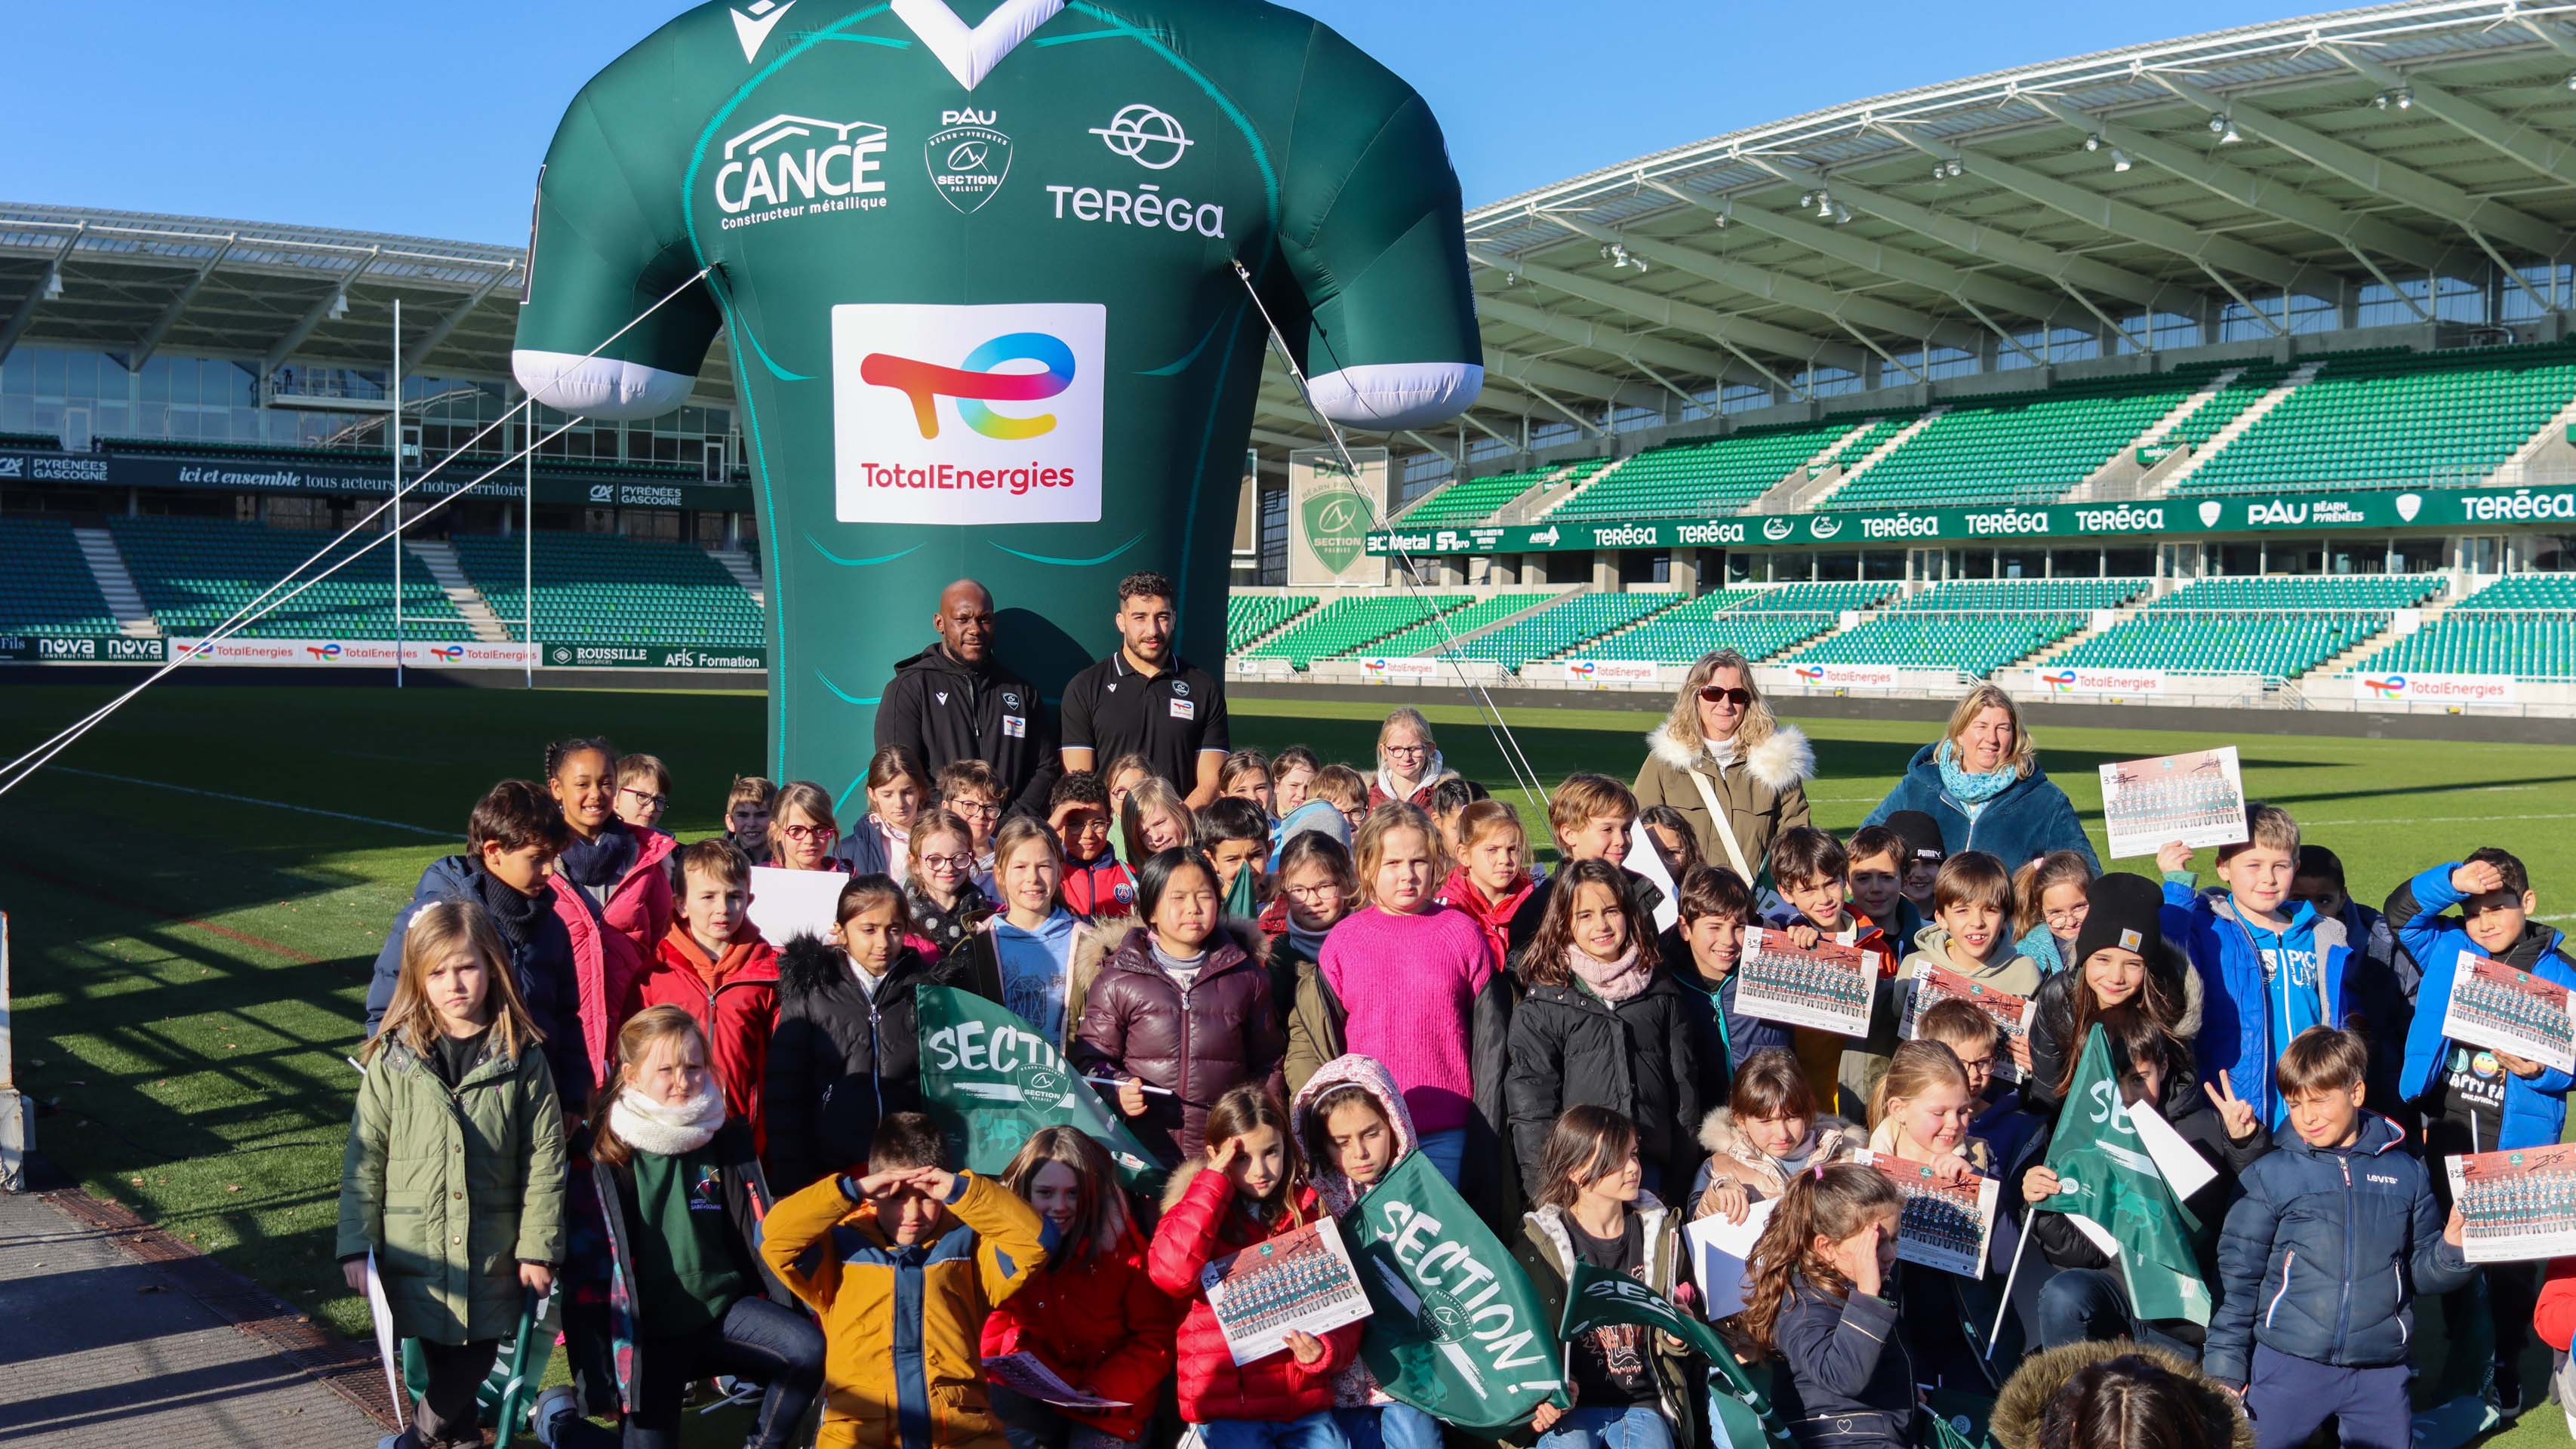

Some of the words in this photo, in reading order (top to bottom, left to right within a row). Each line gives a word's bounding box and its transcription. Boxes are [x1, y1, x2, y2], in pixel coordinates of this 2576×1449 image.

[942, 106, 996, 126] PAU
[716, 131, 888, 214] CANCÉ
[937, 175, 998, 185] SECTION
[722, 205, 804, 230] Constructeur
[810, 195, 888, 214] métallique
[33, 458, 108, 471] PYRÉNÉES
[33, 469, 108, 481] GASCOGNE
[179, 466, 202, 483] ici
[203, 468, 219, 483] et
[223, 469, 301, 488] ensemble
[306, 470, 337, 489] tous
[341, 475, 395, 491] acteurs
[399, 477, 417, 492] de
[423, 478, 460, 494] notre
[860, 461, 1074, 495] TotalEnergies
[621, 485, 682, 497] PYRÉNÉES
[621, 494, 682, 506] GASCOGNE
[2248, 500, 2308, 525] PAU
[2313, 501, 2349, 514] BÉARN
[2313, 510, 2365, 523] PYRÉNÉES
[1314, 537, 1362, 547] SECTION
[1389, 534, 1431, 551] Metal
[39, 638, 95, 654] nova
[108, 638, 162, 654] nova
[217, 646, 294, 659] TotalEnergies
[344, 647, 418, 660] TotalEnergies
[577, 648, 648, 660] ROUSSILLE
[699, 654, 760, 667] Formation
[1386, 661, 1433, 675] TotalEnergies
[1596, 666, 1651, 678] TotalEnergies
[1825, 669, 1891, 684] TotalEnergies
[2079, 675, 2156, 692] TotalEnergies
[2410, 681, 2504, 699] TotalEnergies
[1023, 1089, 1060, 1100] SECTION
